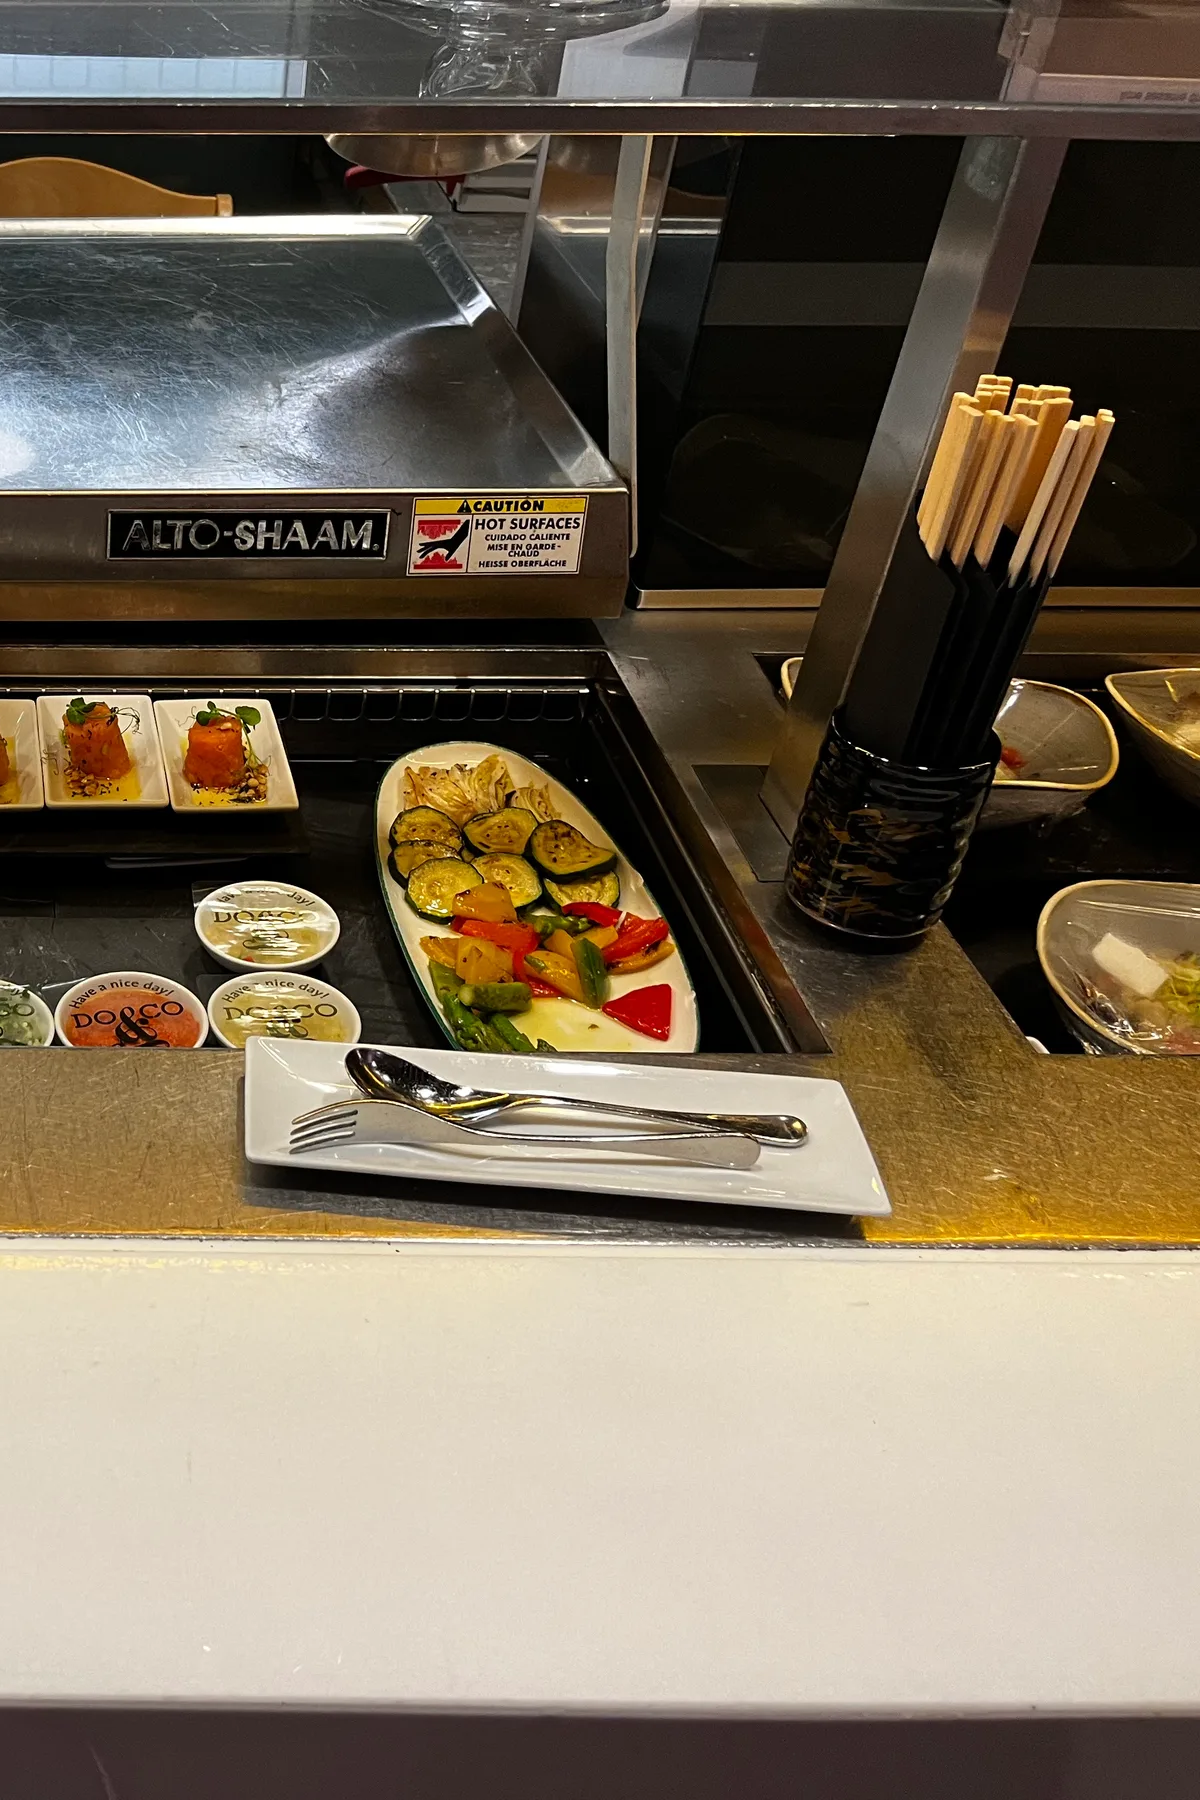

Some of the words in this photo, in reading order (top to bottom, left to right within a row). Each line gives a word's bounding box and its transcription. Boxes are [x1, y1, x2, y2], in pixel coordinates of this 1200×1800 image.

[473, 500, 544, 512] CAUTION
[474, 519, 506, 530] HOT
[509, 518, 581, 530] SURFACES
[484, 533, 526, 542] CUIDADO
[529, 533, 571, 541] CALIENTE
[486, 543, 508, 551] MISE
[508, 550, 540, 558] CHAUD
[478, 560, 508, 568] HEISSE
[69, 988, 98, 1010] Have
[98, 983, 108, 991] a
[110, 979, 140, 989] nice
[143, 981, 176, 997] day!
[221, 984, 252, 1003] Have
[265, 978, 296, 988] nice
[298, 983, 331, 999] day!
[71, 1001, 185, 1047] DO&CO
